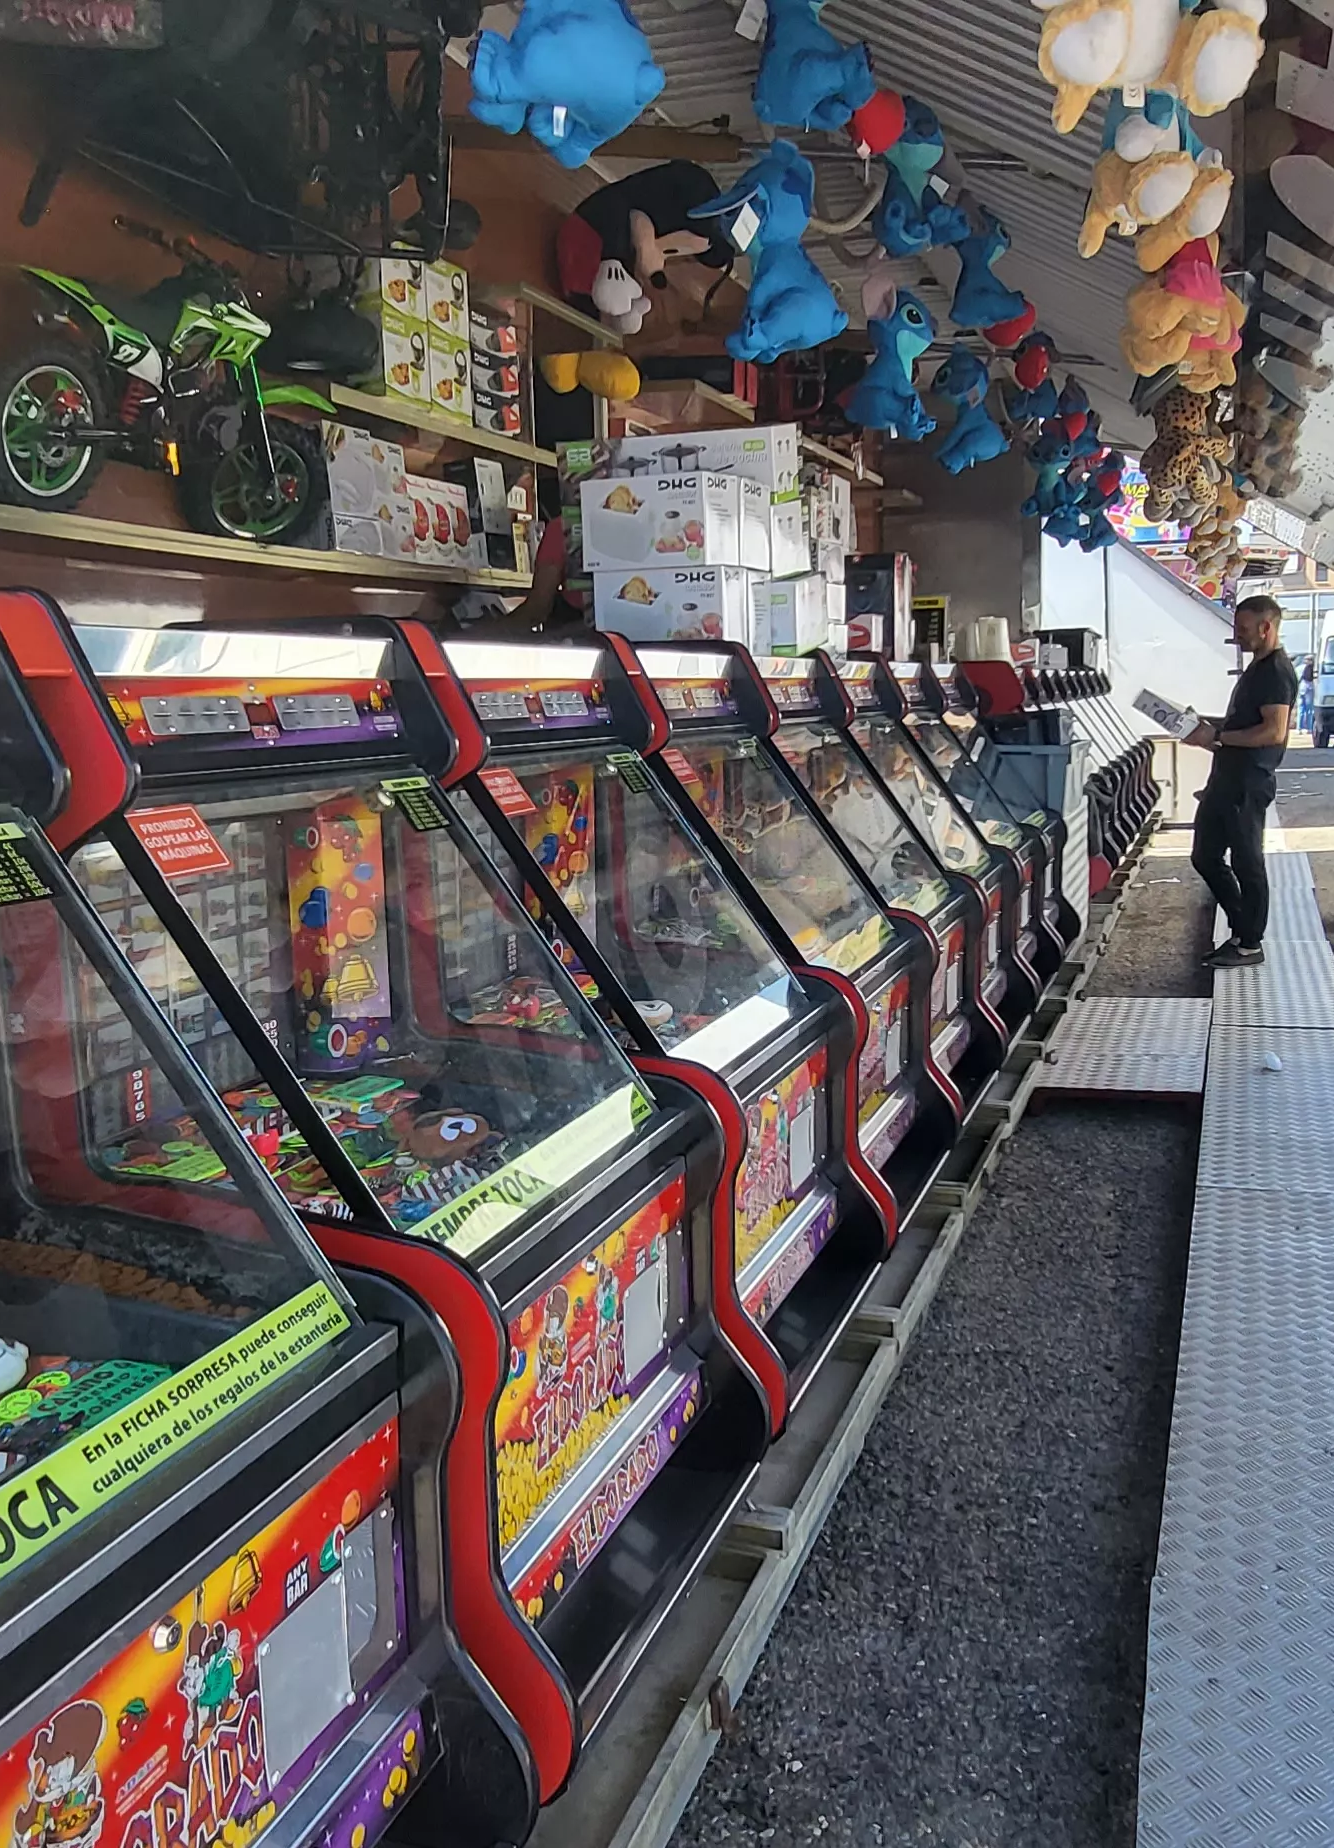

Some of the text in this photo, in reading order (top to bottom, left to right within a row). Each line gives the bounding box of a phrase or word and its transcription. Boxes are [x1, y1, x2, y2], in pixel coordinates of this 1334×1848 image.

[658, 477, 696, 491] DHG
[707, 477, 727, 489] DHG
[744, 484, 762, 497] DHG
[675, 571, 715, 583] DHG
[139, 817, 196, 834] PROHIBIDO
[144, 829, 210, 849] GOLPEAR LAS
[157, 842, 214, 861] MÁQUINAS
[132, 1069, 142, 1079] 9
[133, 1080, 143, 1090] 8
[134, 1090, 144, 1101] 7
[81, 1291, 329, 1465] En la FICHA SORPRESA puede conseguir
[92, 1311, 343, 1494] cualquiera de los regalos de la estantería
[570, 1430, 660, 1569] ELDORADO
[286, 1557, 308, 1587] ANY
[286, 1573, 308, 1608] BAR
